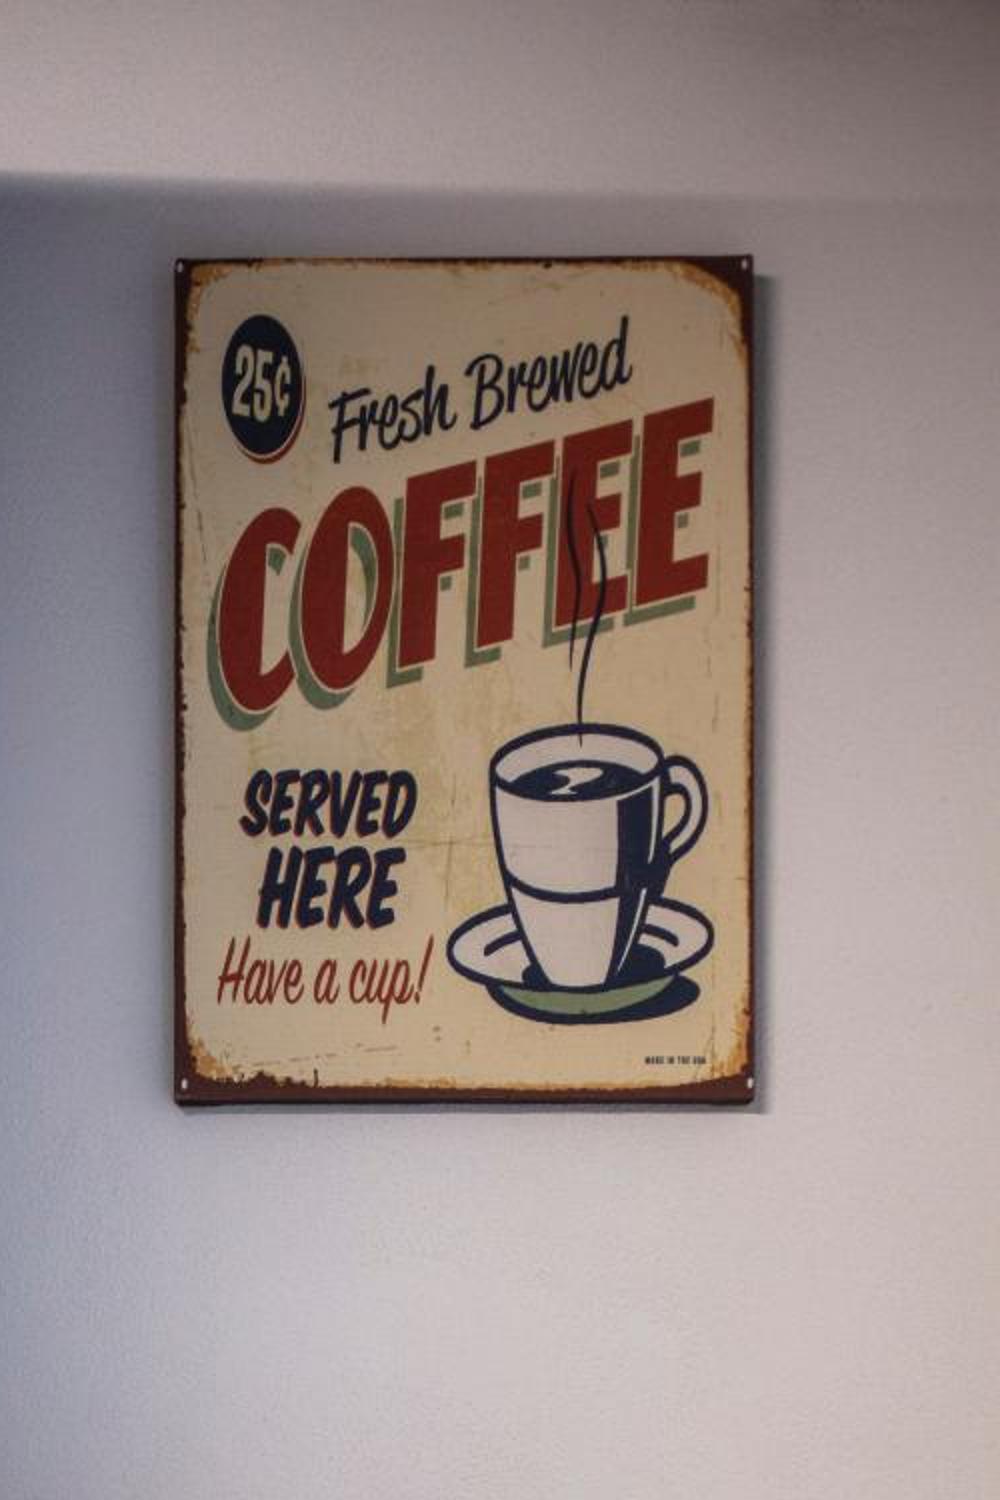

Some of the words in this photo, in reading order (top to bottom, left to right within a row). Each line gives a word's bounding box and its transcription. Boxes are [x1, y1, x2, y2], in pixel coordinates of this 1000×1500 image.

[232, 345, 292, 424] 25¢
[328, 365, 458, 464] Fresh
[464, 315, 632, 430] Brewed
[207, 397, 714, 731] COFFEE
[239, 768, 418, 838] SERVED
[255, 846, 407, 930] HERE
[216, 936, 304, 1005] Have
[313, 958, 341, 1005] a
[348, 935, 435, 1025] cup!
